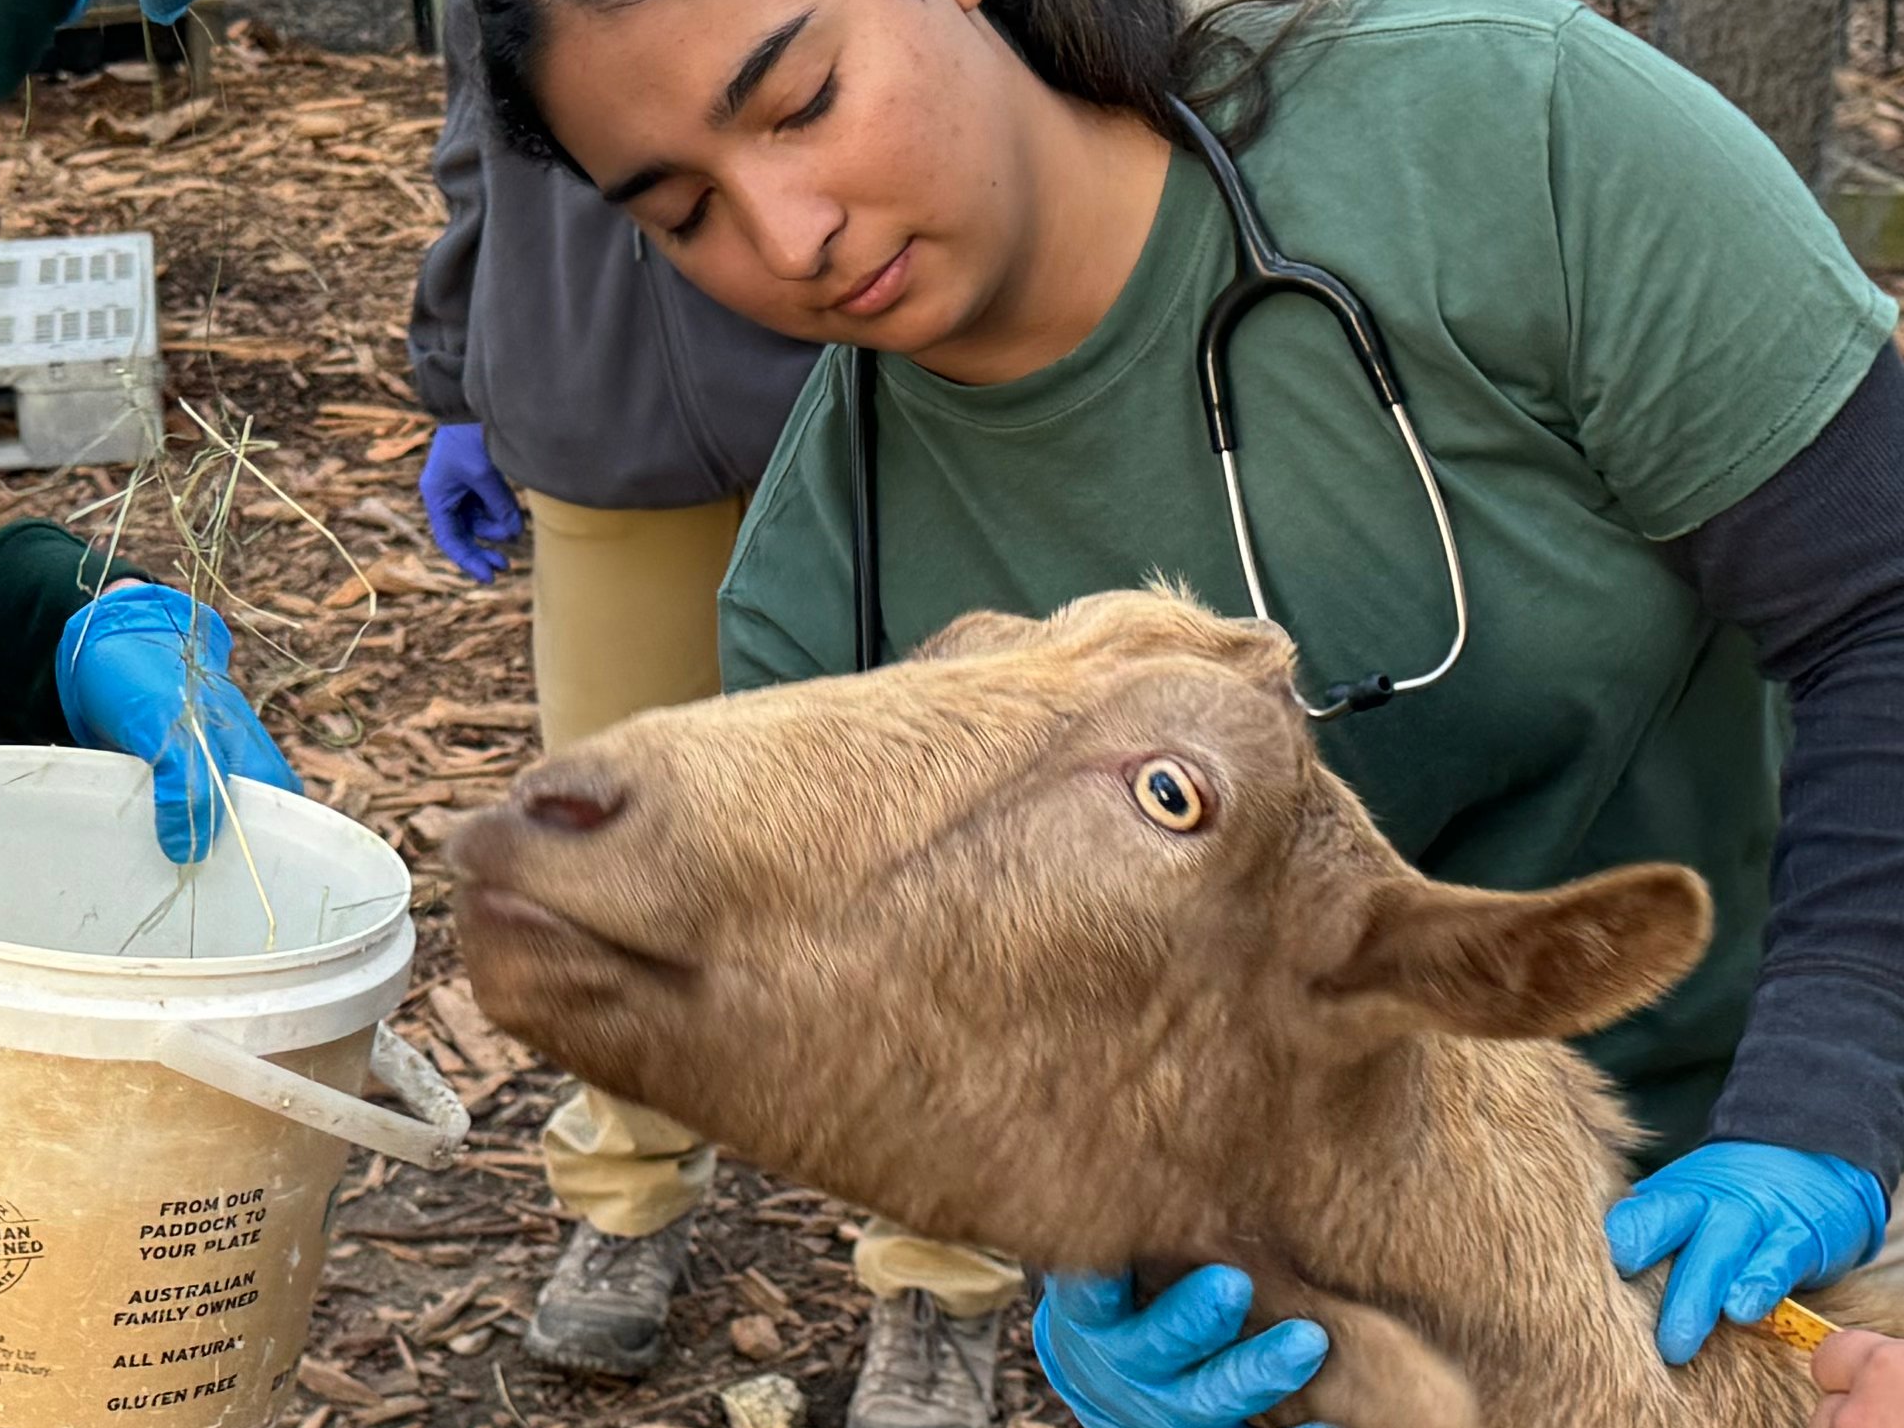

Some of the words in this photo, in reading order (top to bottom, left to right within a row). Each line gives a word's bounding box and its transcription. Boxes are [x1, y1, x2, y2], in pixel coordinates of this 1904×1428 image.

[159, 1196, 220, 1217] FROM
[226, 1188, 264, 1208] OUR
[139, 1213, 239, 1240] PADDOCK
[246, 1208, 267, 1224] TO
[139, 1243, 197, 1261] YOUR
[203, 1228, 262, 1254] PLATE
[128, 1270, 257, 1305] AUSTRALIAN
[113, 1306, 191, 1327] FAMILY
[195, 1290, 259, 1318] OWNED
[112, 1353, 154, 1369] ALL
[106, 1388, 188, 1412] GLUTEN
[193, 1373, 238, 1400] FREE
